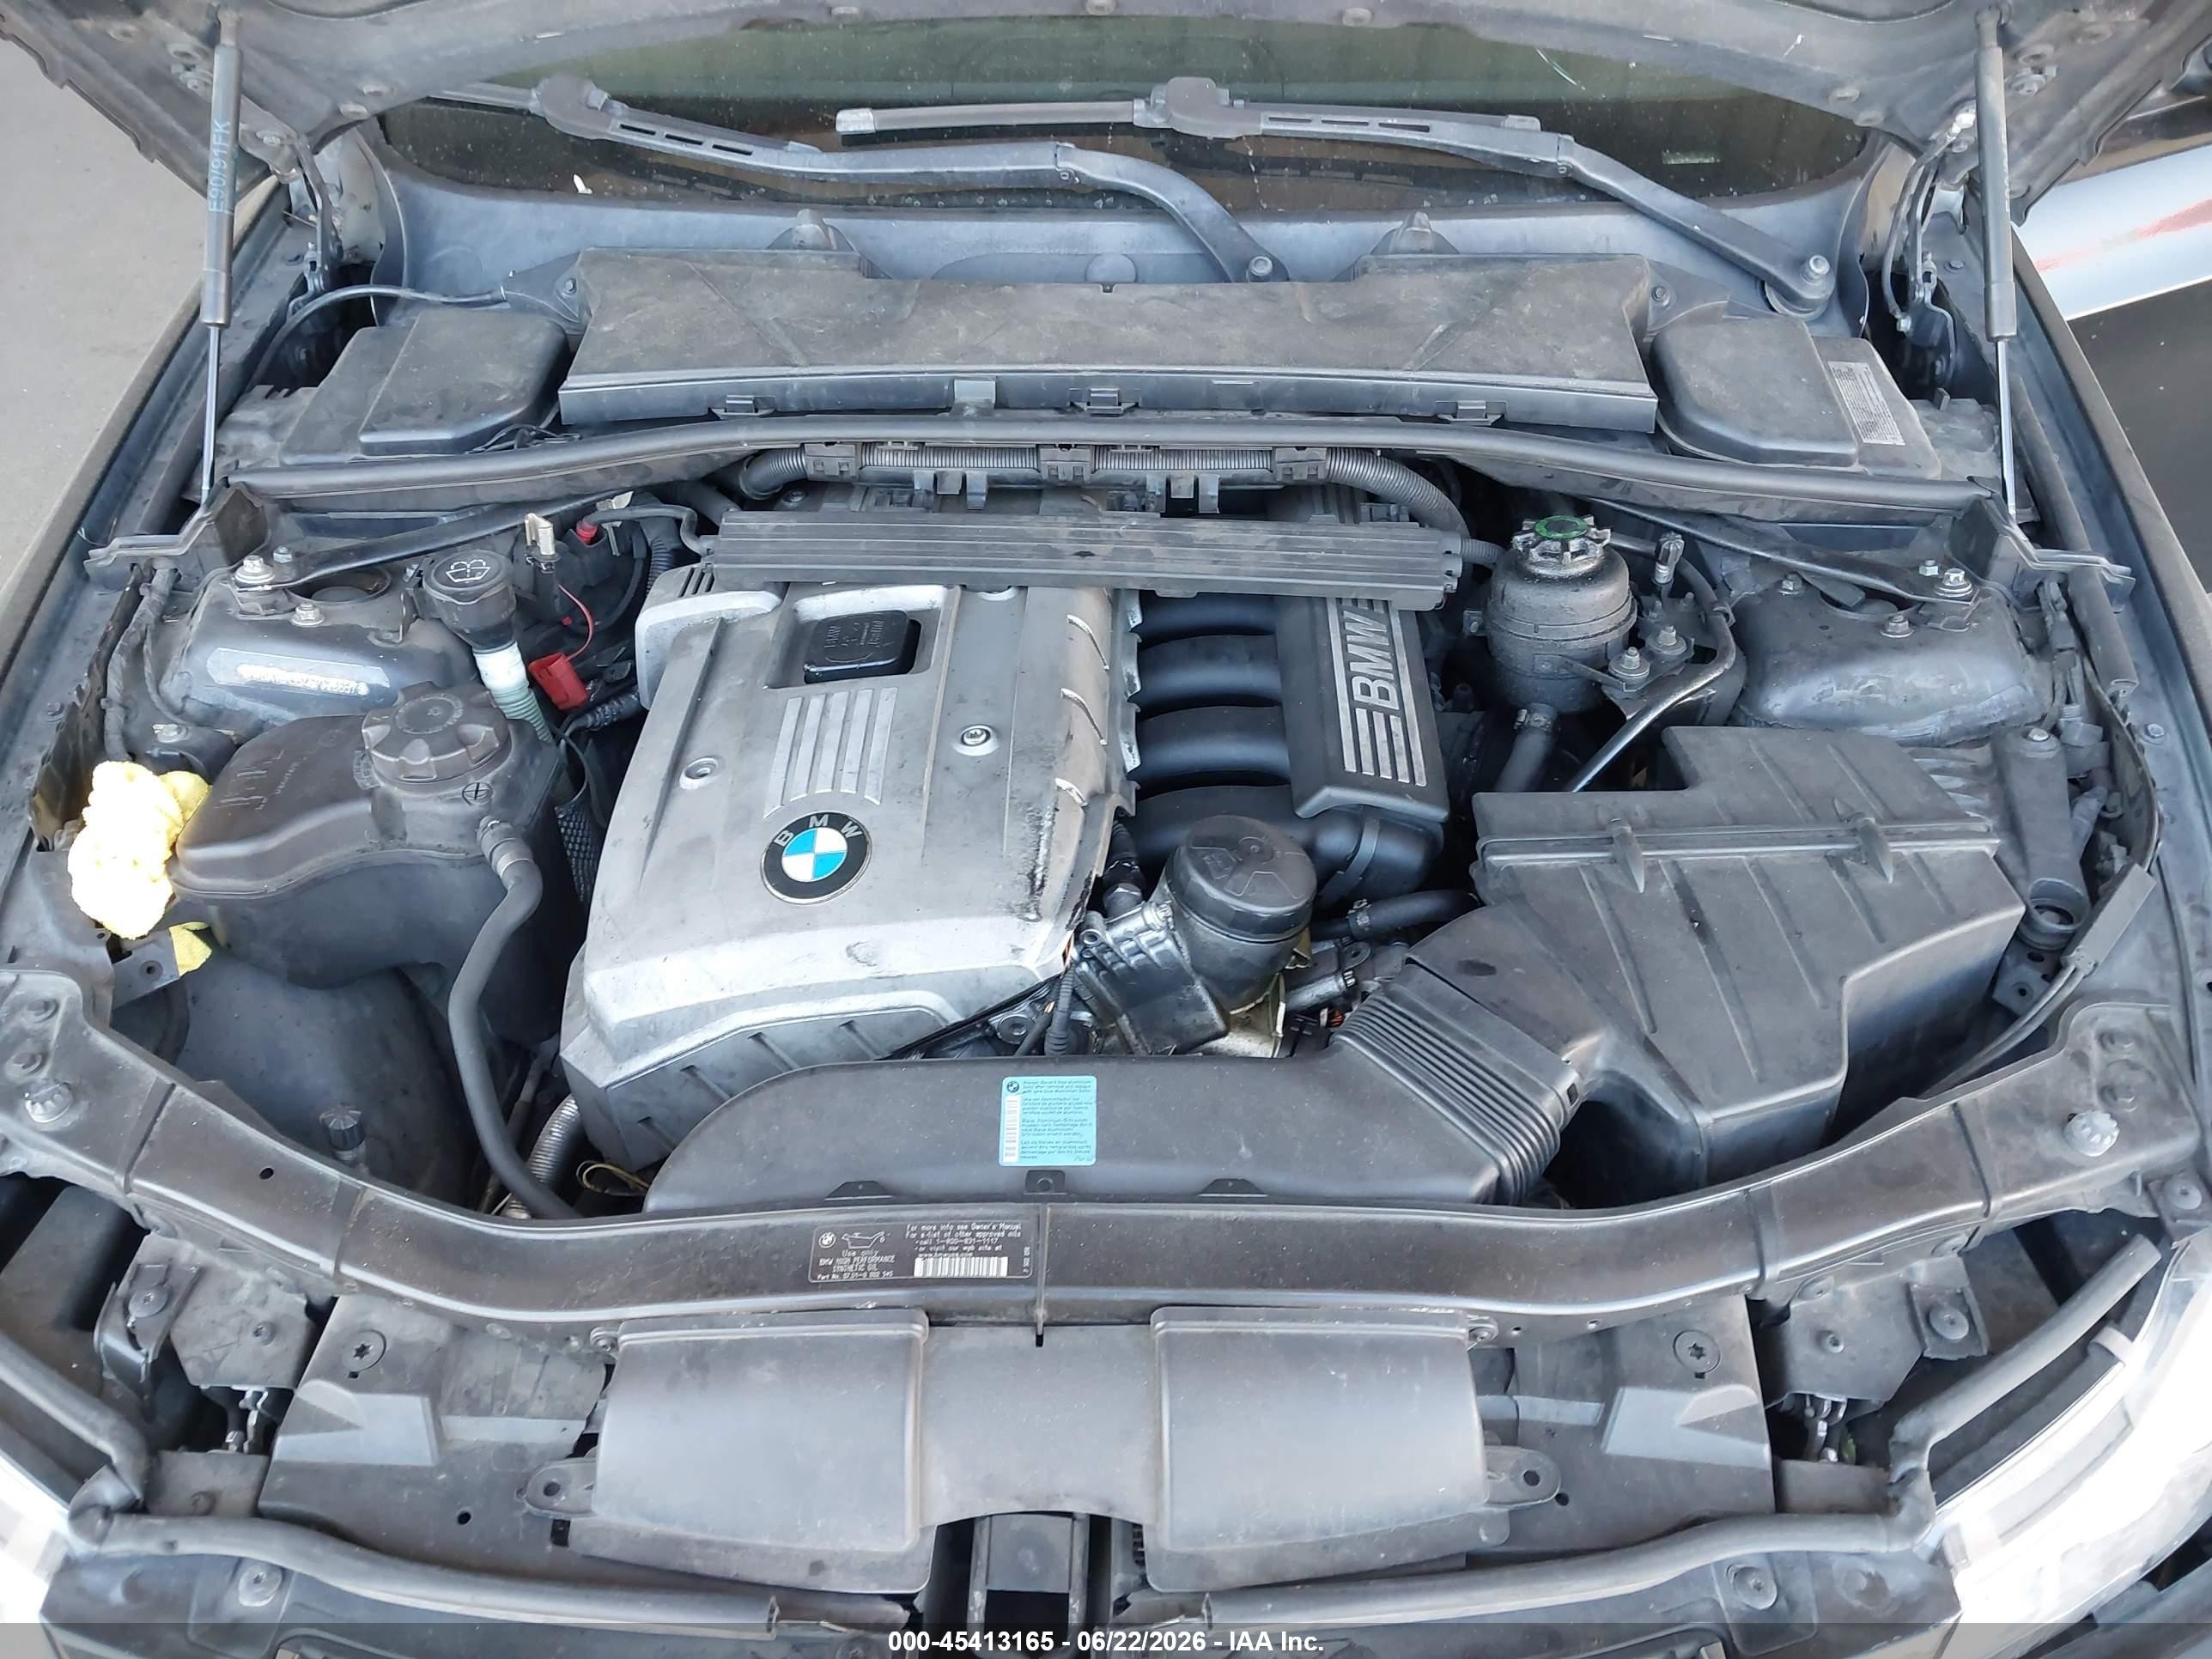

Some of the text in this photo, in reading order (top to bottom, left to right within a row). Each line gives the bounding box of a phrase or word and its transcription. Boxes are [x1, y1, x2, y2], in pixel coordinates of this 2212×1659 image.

[209, 119, 230, 212] E90/91FK
[1343, 610, 1400, 710] BMW
[774, 814, 864, 847] BMW
[905, 1231, 918, 1240] For
[954, 1230, 973, 1238] other
[975, 1230, 1006, 1239] approved
[1007, 1229, 1022, 1238] oils
[999, 1222, 1022, 1231] Manual
